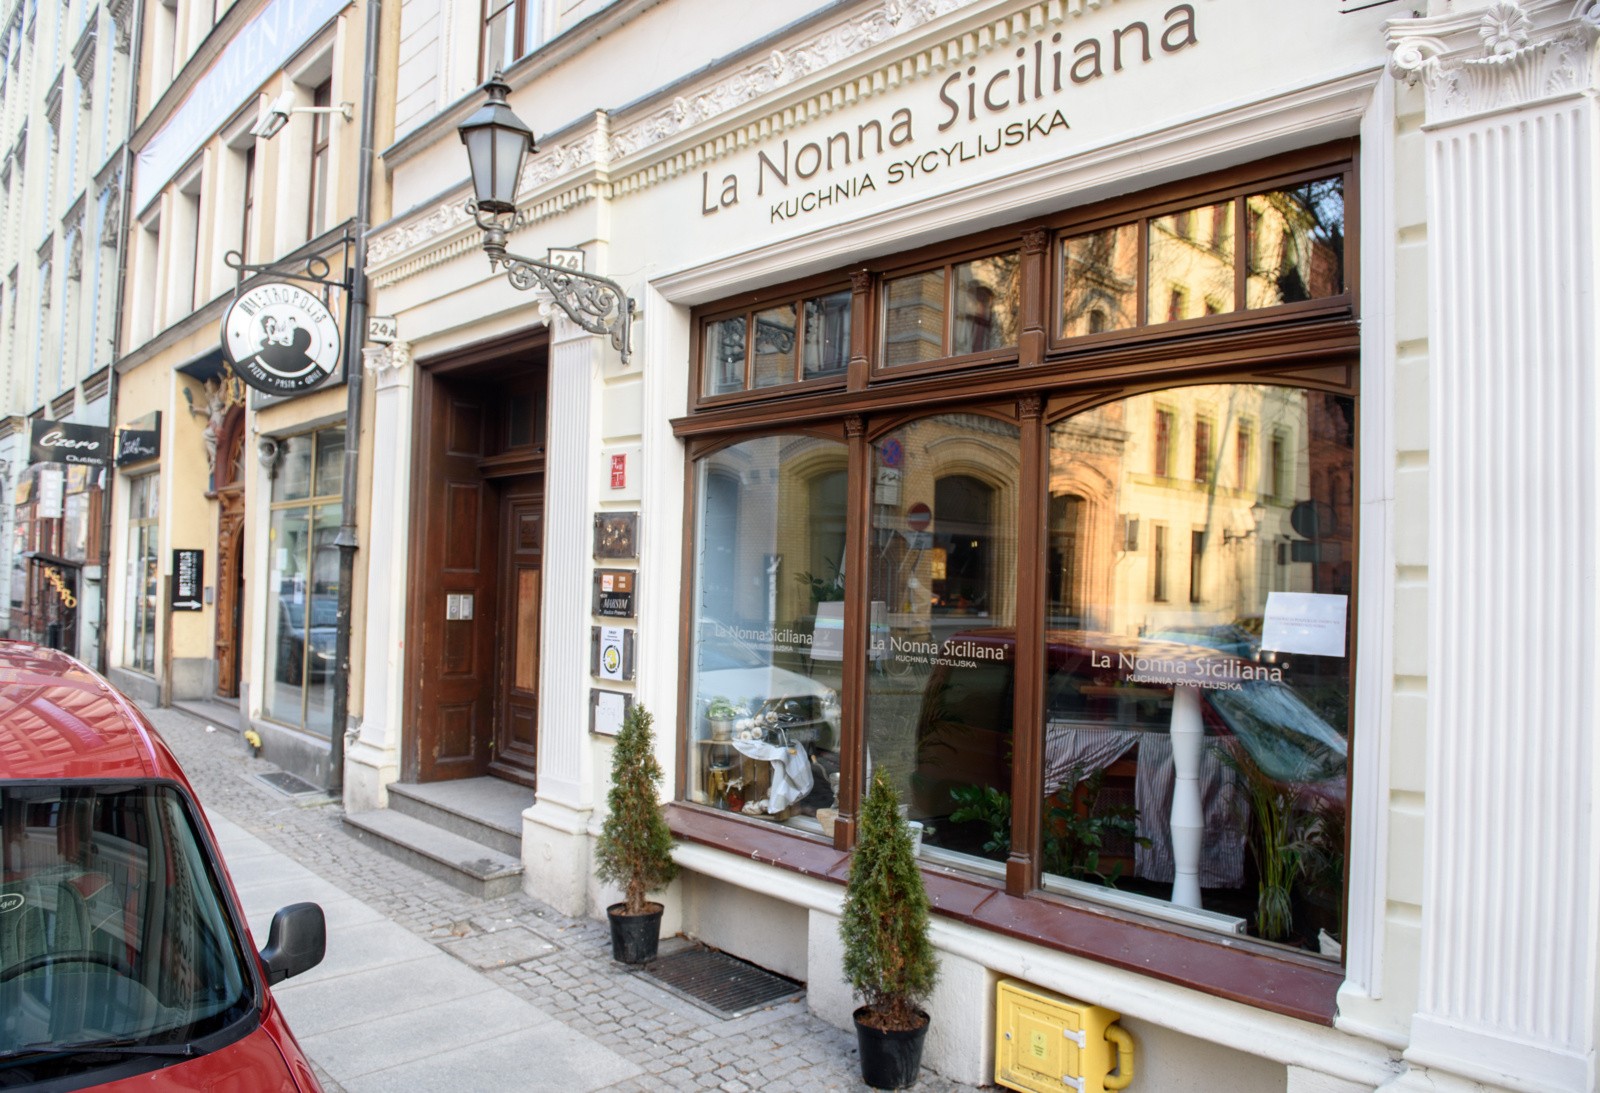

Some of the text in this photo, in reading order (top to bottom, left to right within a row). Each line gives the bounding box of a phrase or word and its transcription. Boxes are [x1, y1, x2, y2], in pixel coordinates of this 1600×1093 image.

[702, 3, 1198, 215] La Nonna Siciliana
[770, 109, 1070, 223] KUCHNIA SYCYLIJSKA
[247, 361, 267, 381] PIZZA
[275, 378, 296, 389] PASTA
[39, 431, 100, 450] Czero
[65, 454, 104, 465] Outlet
[44, 566, 77, 608] KSERO
[870, 635, 885, 650] La
[890, 637, 938, 655] Nonna
[895, 654, 978, 669] KUCHNIA SYCYLIJSKA
[1091, 650, 1111, 668] La
[1118, 653, 1187, 674] Nonna
[1126, 674, 1244, 692] KUCHNIA SYCYLIJSKA
